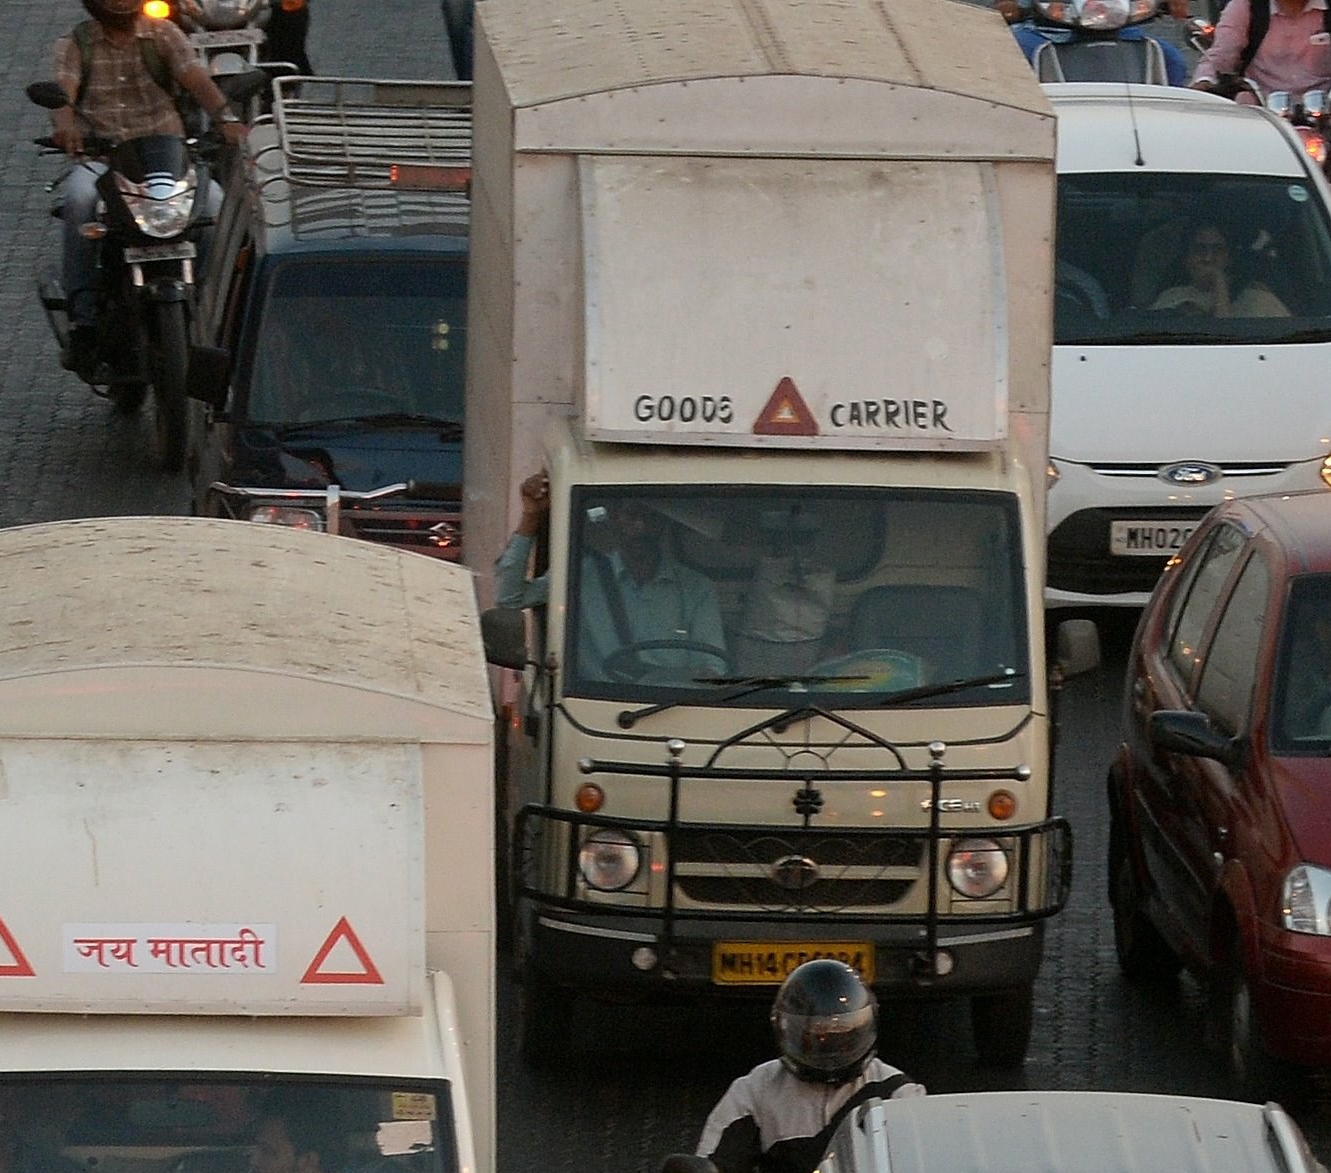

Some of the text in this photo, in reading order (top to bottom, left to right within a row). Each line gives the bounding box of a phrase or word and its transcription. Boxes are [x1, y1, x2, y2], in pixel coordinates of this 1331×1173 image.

[634, 394, 954, 432] GOODS CARRIER
[73, 928, 266, 968] जय मातादी
